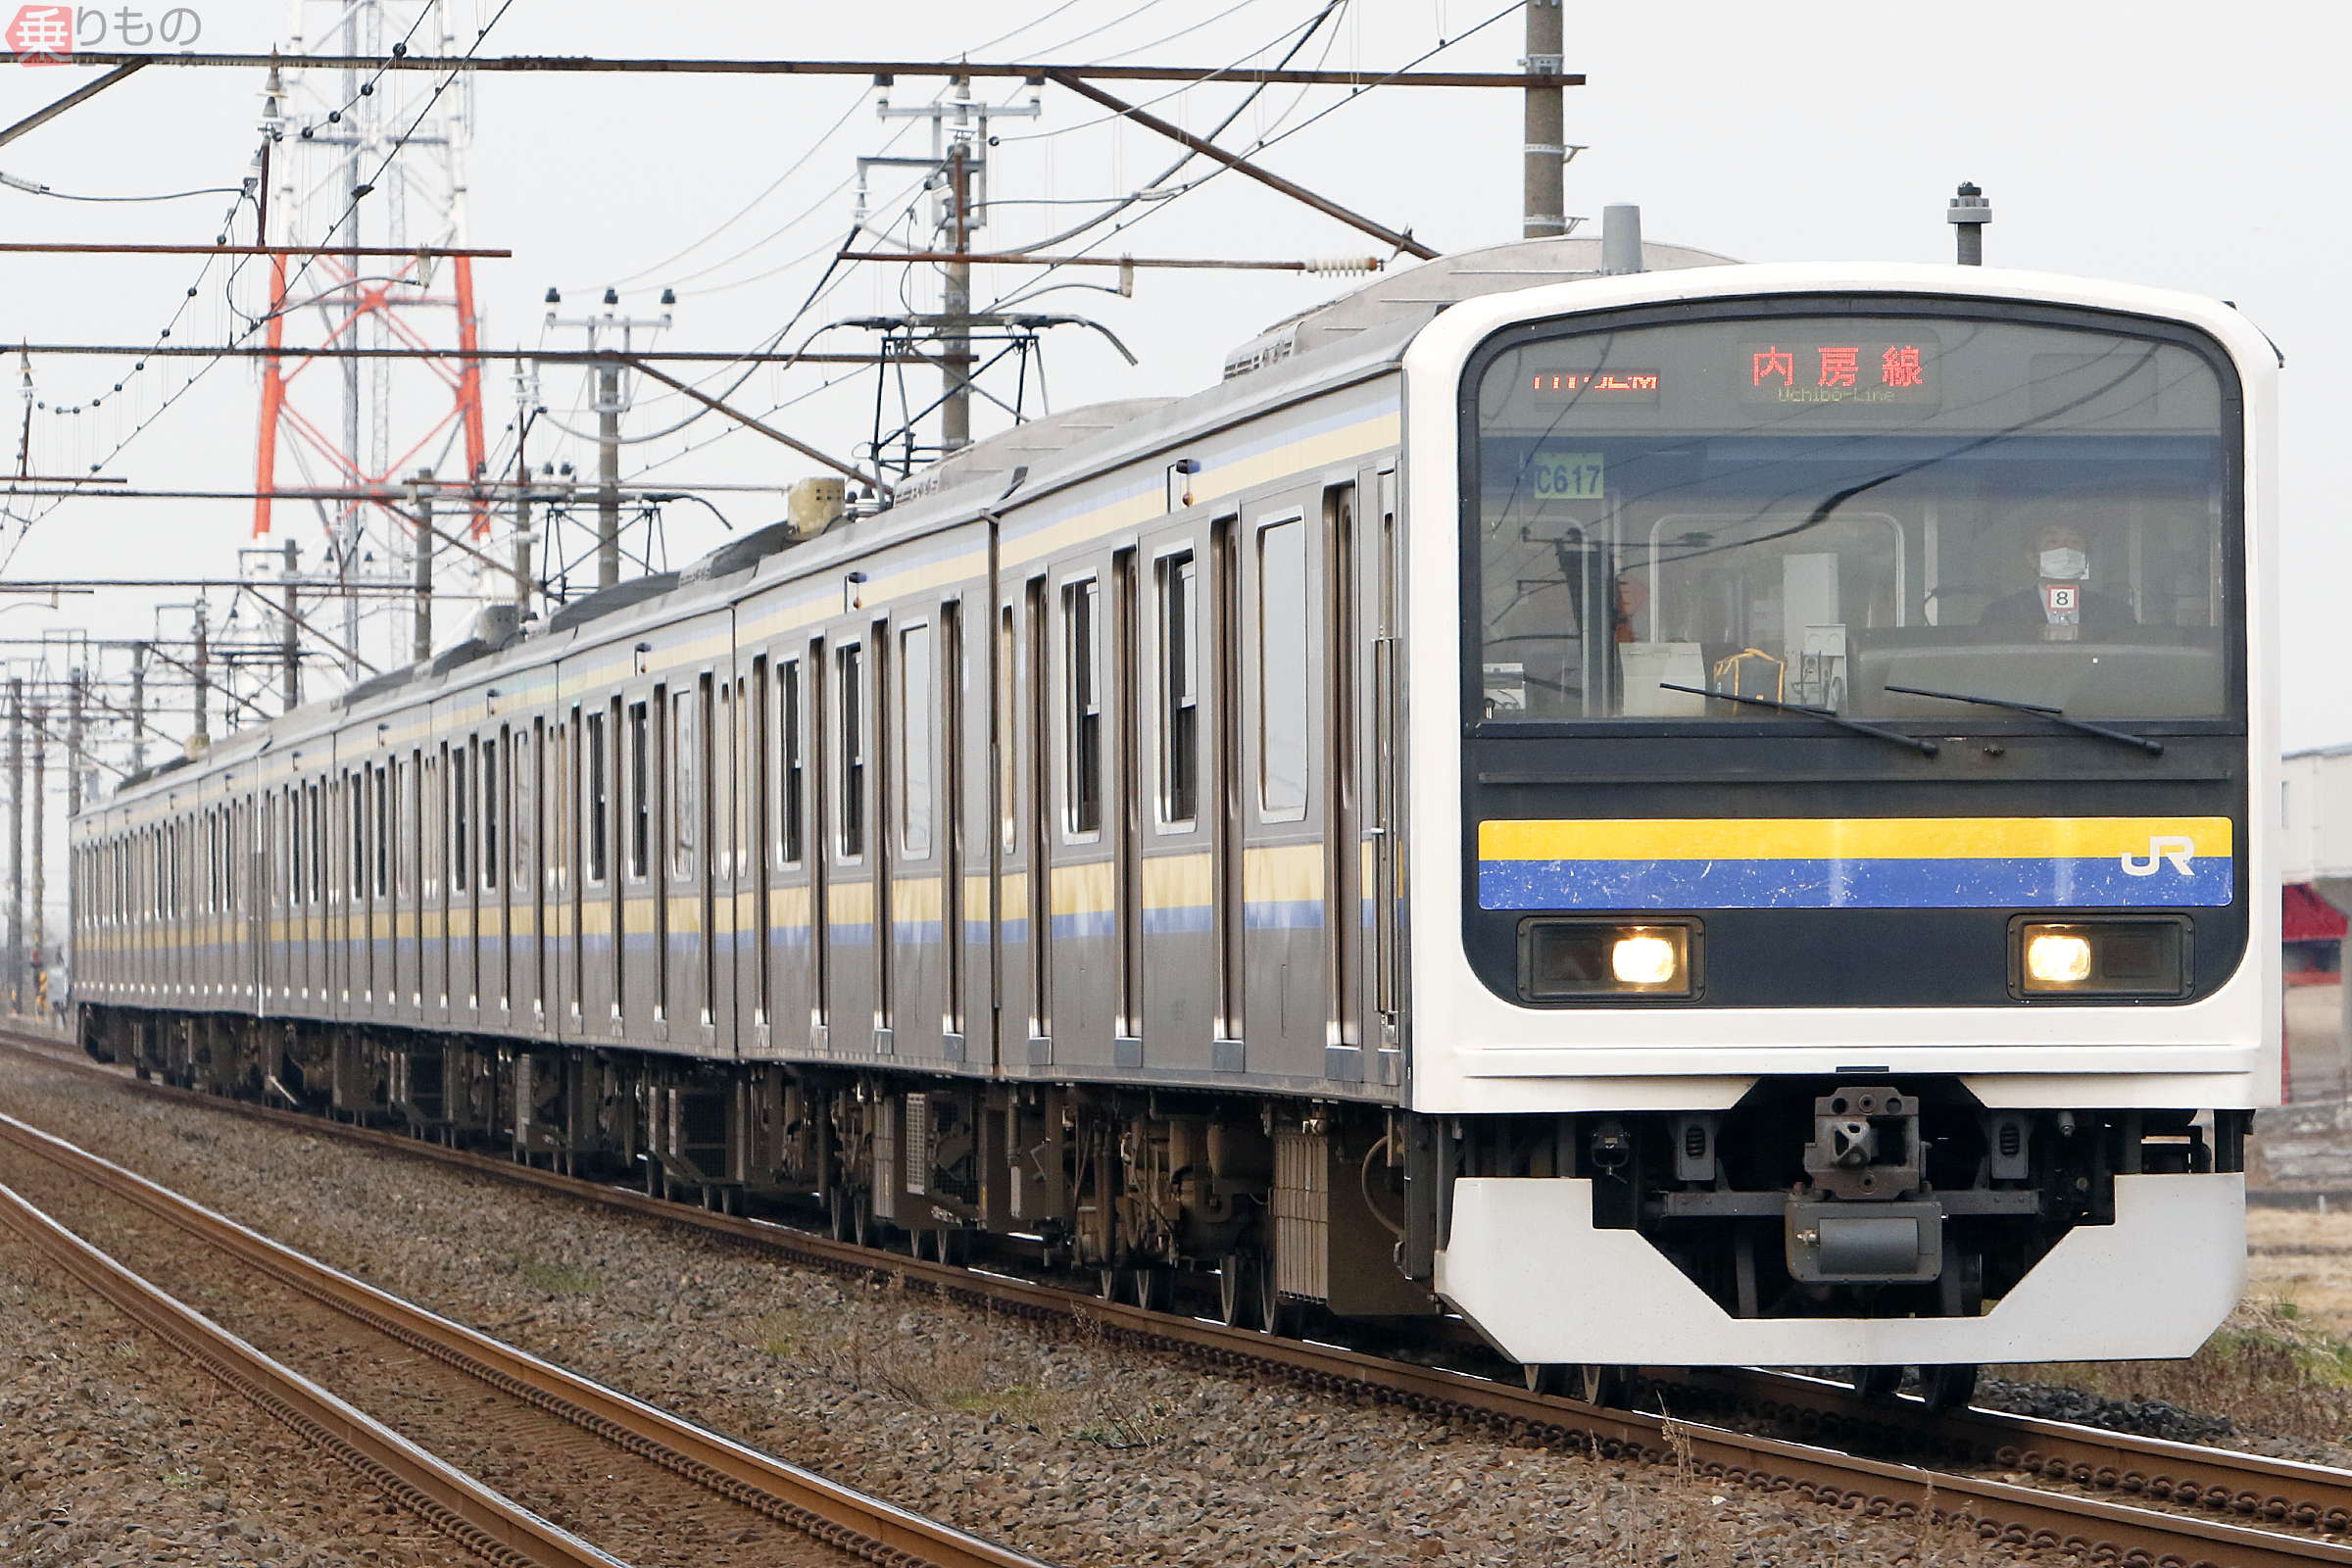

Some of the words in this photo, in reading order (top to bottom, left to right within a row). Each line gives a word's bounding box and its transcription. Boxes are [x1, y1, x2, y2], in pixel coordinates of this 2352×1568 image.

[1752, 345, 1923, 387] 内房線
[1536, 464, 1600, 495] C617
[2056, 590, 2069, 606] 8
[2120, 835, 2196, 877] JR
